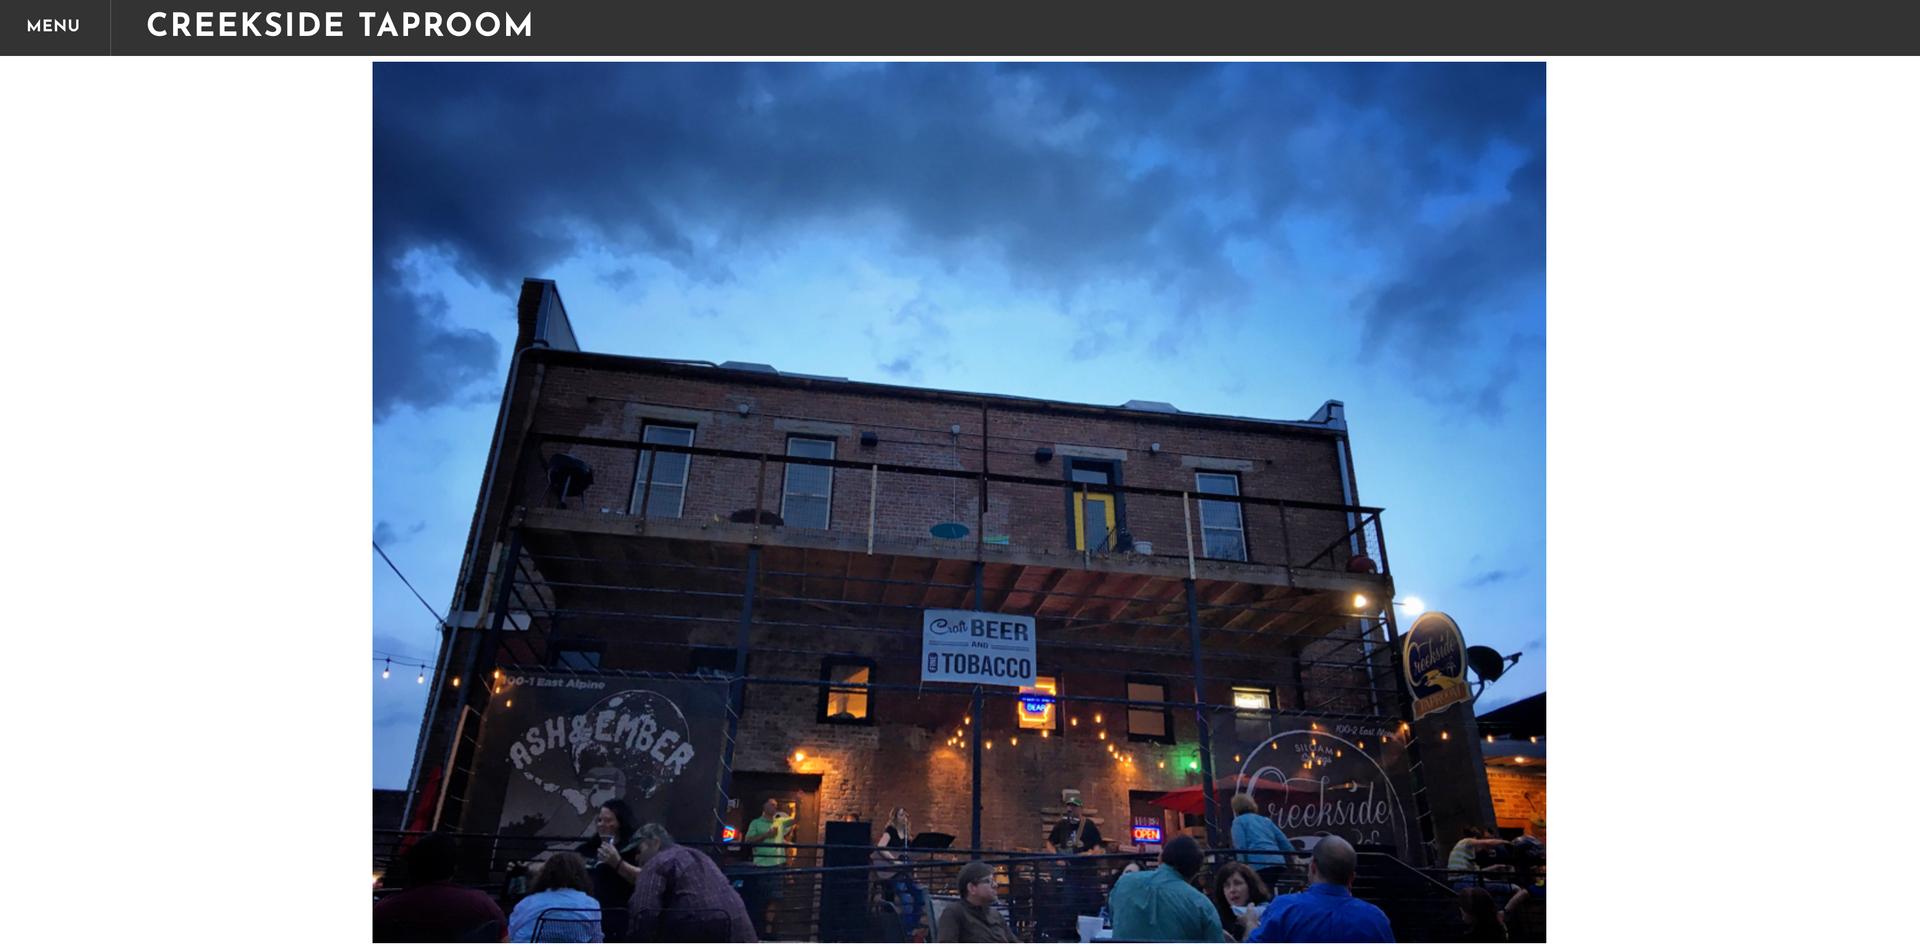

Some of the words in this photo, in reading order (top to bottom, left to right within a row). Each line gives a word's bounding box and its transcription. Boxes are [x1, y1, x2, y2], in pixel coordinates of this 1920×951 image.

[929, 618, 968, 635] Craft
[971, 619, 1028, 641] BEER
[971, 641, 989, 649] AND
[929, 654, 938, 671] FINE
[942, 653, 1031, 679] TOBACCO
[502, 675, 535, 687] 100-1
[536, 677, 564, 688] East
[565, 678, 606, 690] Alpine
[1419, 686, 1462, 712] TAPROOM
[1335, 724, 1358, 735] 100-2
[1359, 726, 1376, 736] East
[1294, 743, 1334, 755] SILOAM
[1133, 829, 1160, 840] OPEN
